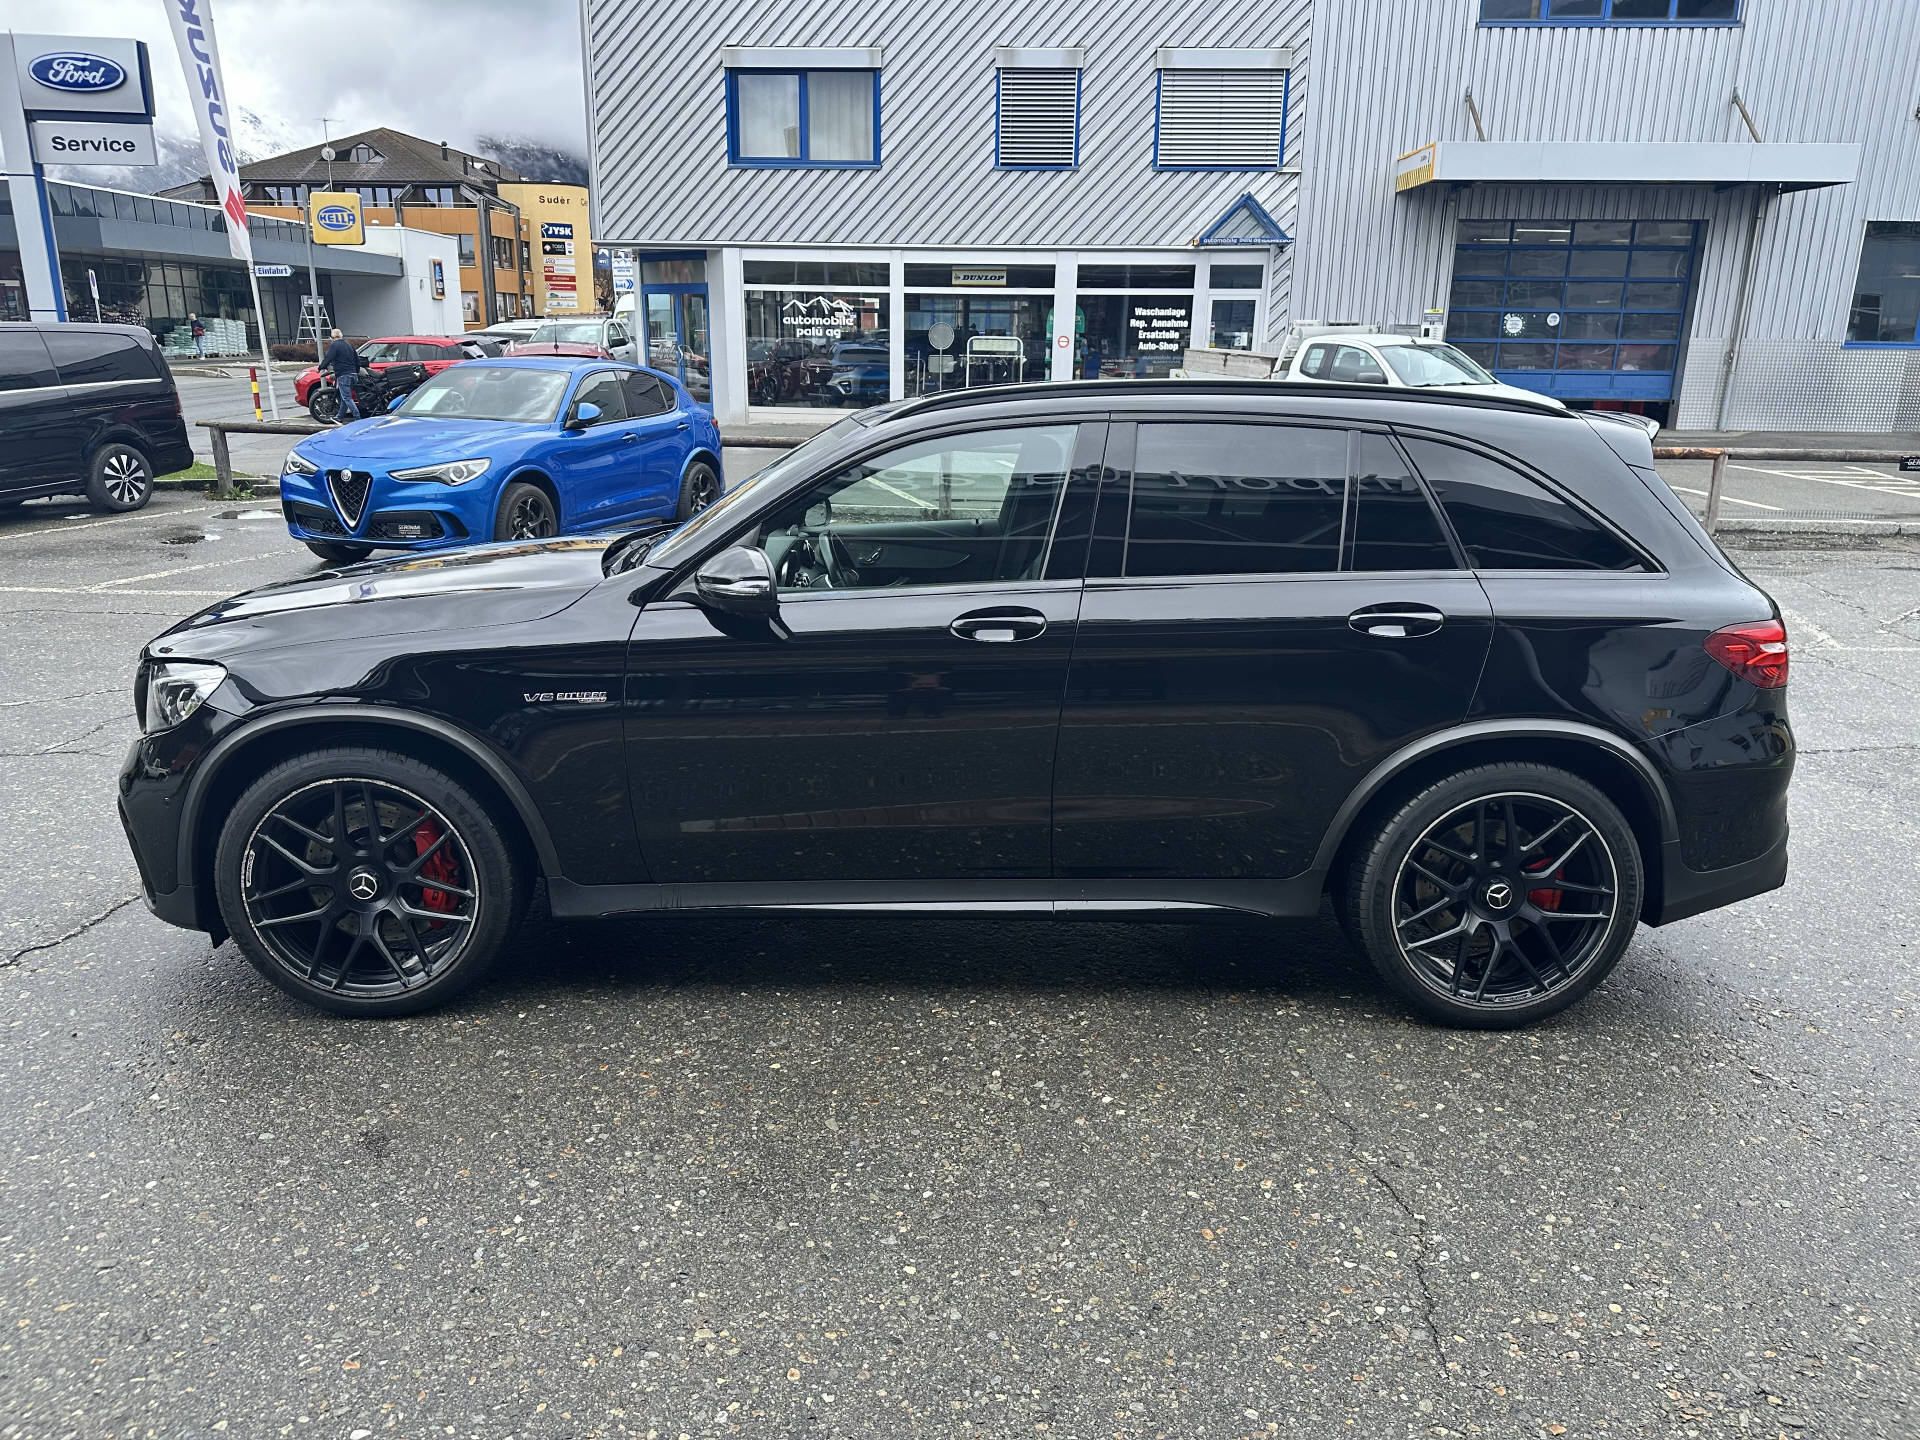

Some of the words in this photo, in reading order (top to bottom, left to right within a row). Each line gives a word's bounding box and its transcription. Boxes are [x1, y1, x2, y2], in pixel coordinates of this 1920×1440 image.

[48, 58, 105, 84] Ford
[52, 136, 136, 153] Service
[320, 212, 356, 224] HELLA
[548, 227, 572, 236] JYSK
[257, 266, 289, 277] Einfahrt
[1135, 307, 1186, 317] Waschanlage
[782, 315, 854, 326] automobile
[1130, 319, 1148, 329] Rep.
[1151, 318, 1188, 328] Annahme
[825, 328, 842, 339] ag
[1138, 330, 1179, 339] Ersatzteile
[1138, 341, 1179, 351] Auto-Shop
